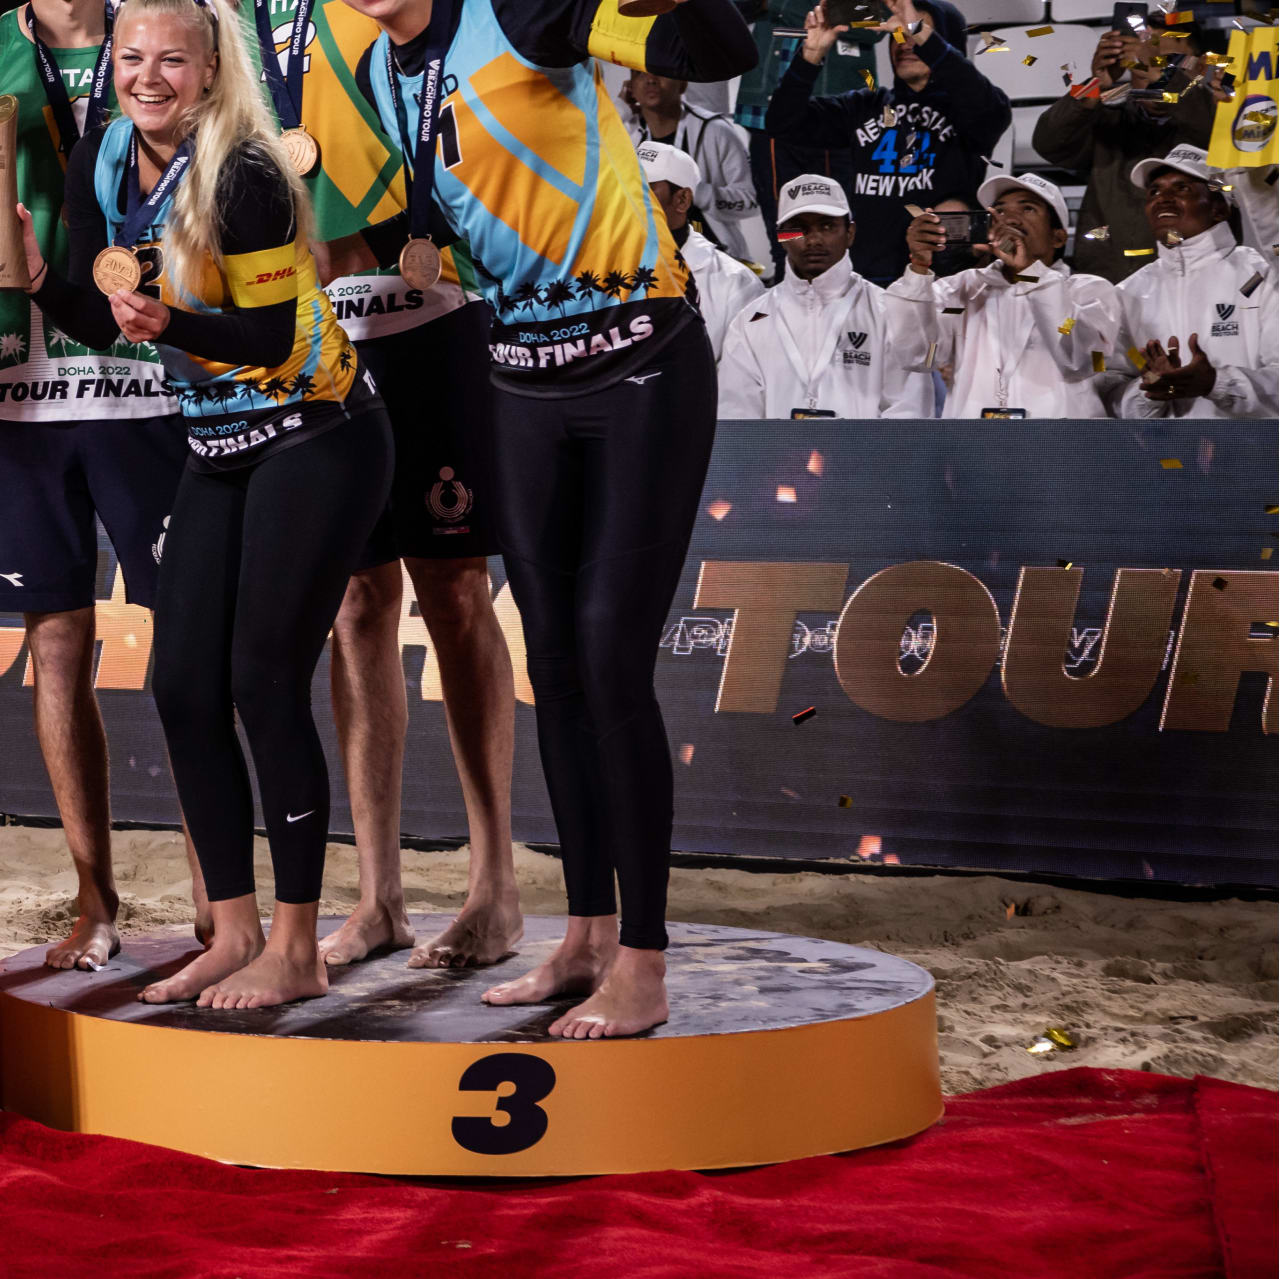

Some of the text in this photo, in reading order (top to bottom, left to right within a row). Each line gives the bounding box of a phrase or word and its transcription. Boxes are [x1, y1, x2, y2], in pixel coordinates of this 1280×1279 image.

[294, 16, 306, 35] PRO
[260, 19, 317, 83] 2
[291, 34, 303, 56] TOUR
[44, 61, 56, 84] TOUR
[60, 68, 94, 88] TA
[97, 60, 108, 79] PRO
[93, 78, 105, 99] TOUR
[420, 69, 439, 142] BEACH PRO TOUR
[438, 101, 463, 172] 1
[148, 160, 184, 207] BEACH PRO TOUR
[802, 184, 832, 192] BEACH
[855, 172, 895, 197] NEW
[136, 246, 165, 301] 2
[255, 266, 297, 285] DHL
[336, 283, 373, 297] 2022
[518, 323, 590, 344] DOHA 2022
[1211, 322, 1240, 332] BEACH
[538, 314, 654, 369] FINALS
[843, 351, 872, 361] BEACH
[57, 365, 132, 377] DOHA 2022
[74, 378, 177, 400] FINALS
[191, 420, 250, 438] DOHA 2022
[692, 560, 1278, 734] TOUR
[452, 1053, 555, 1154] 3
